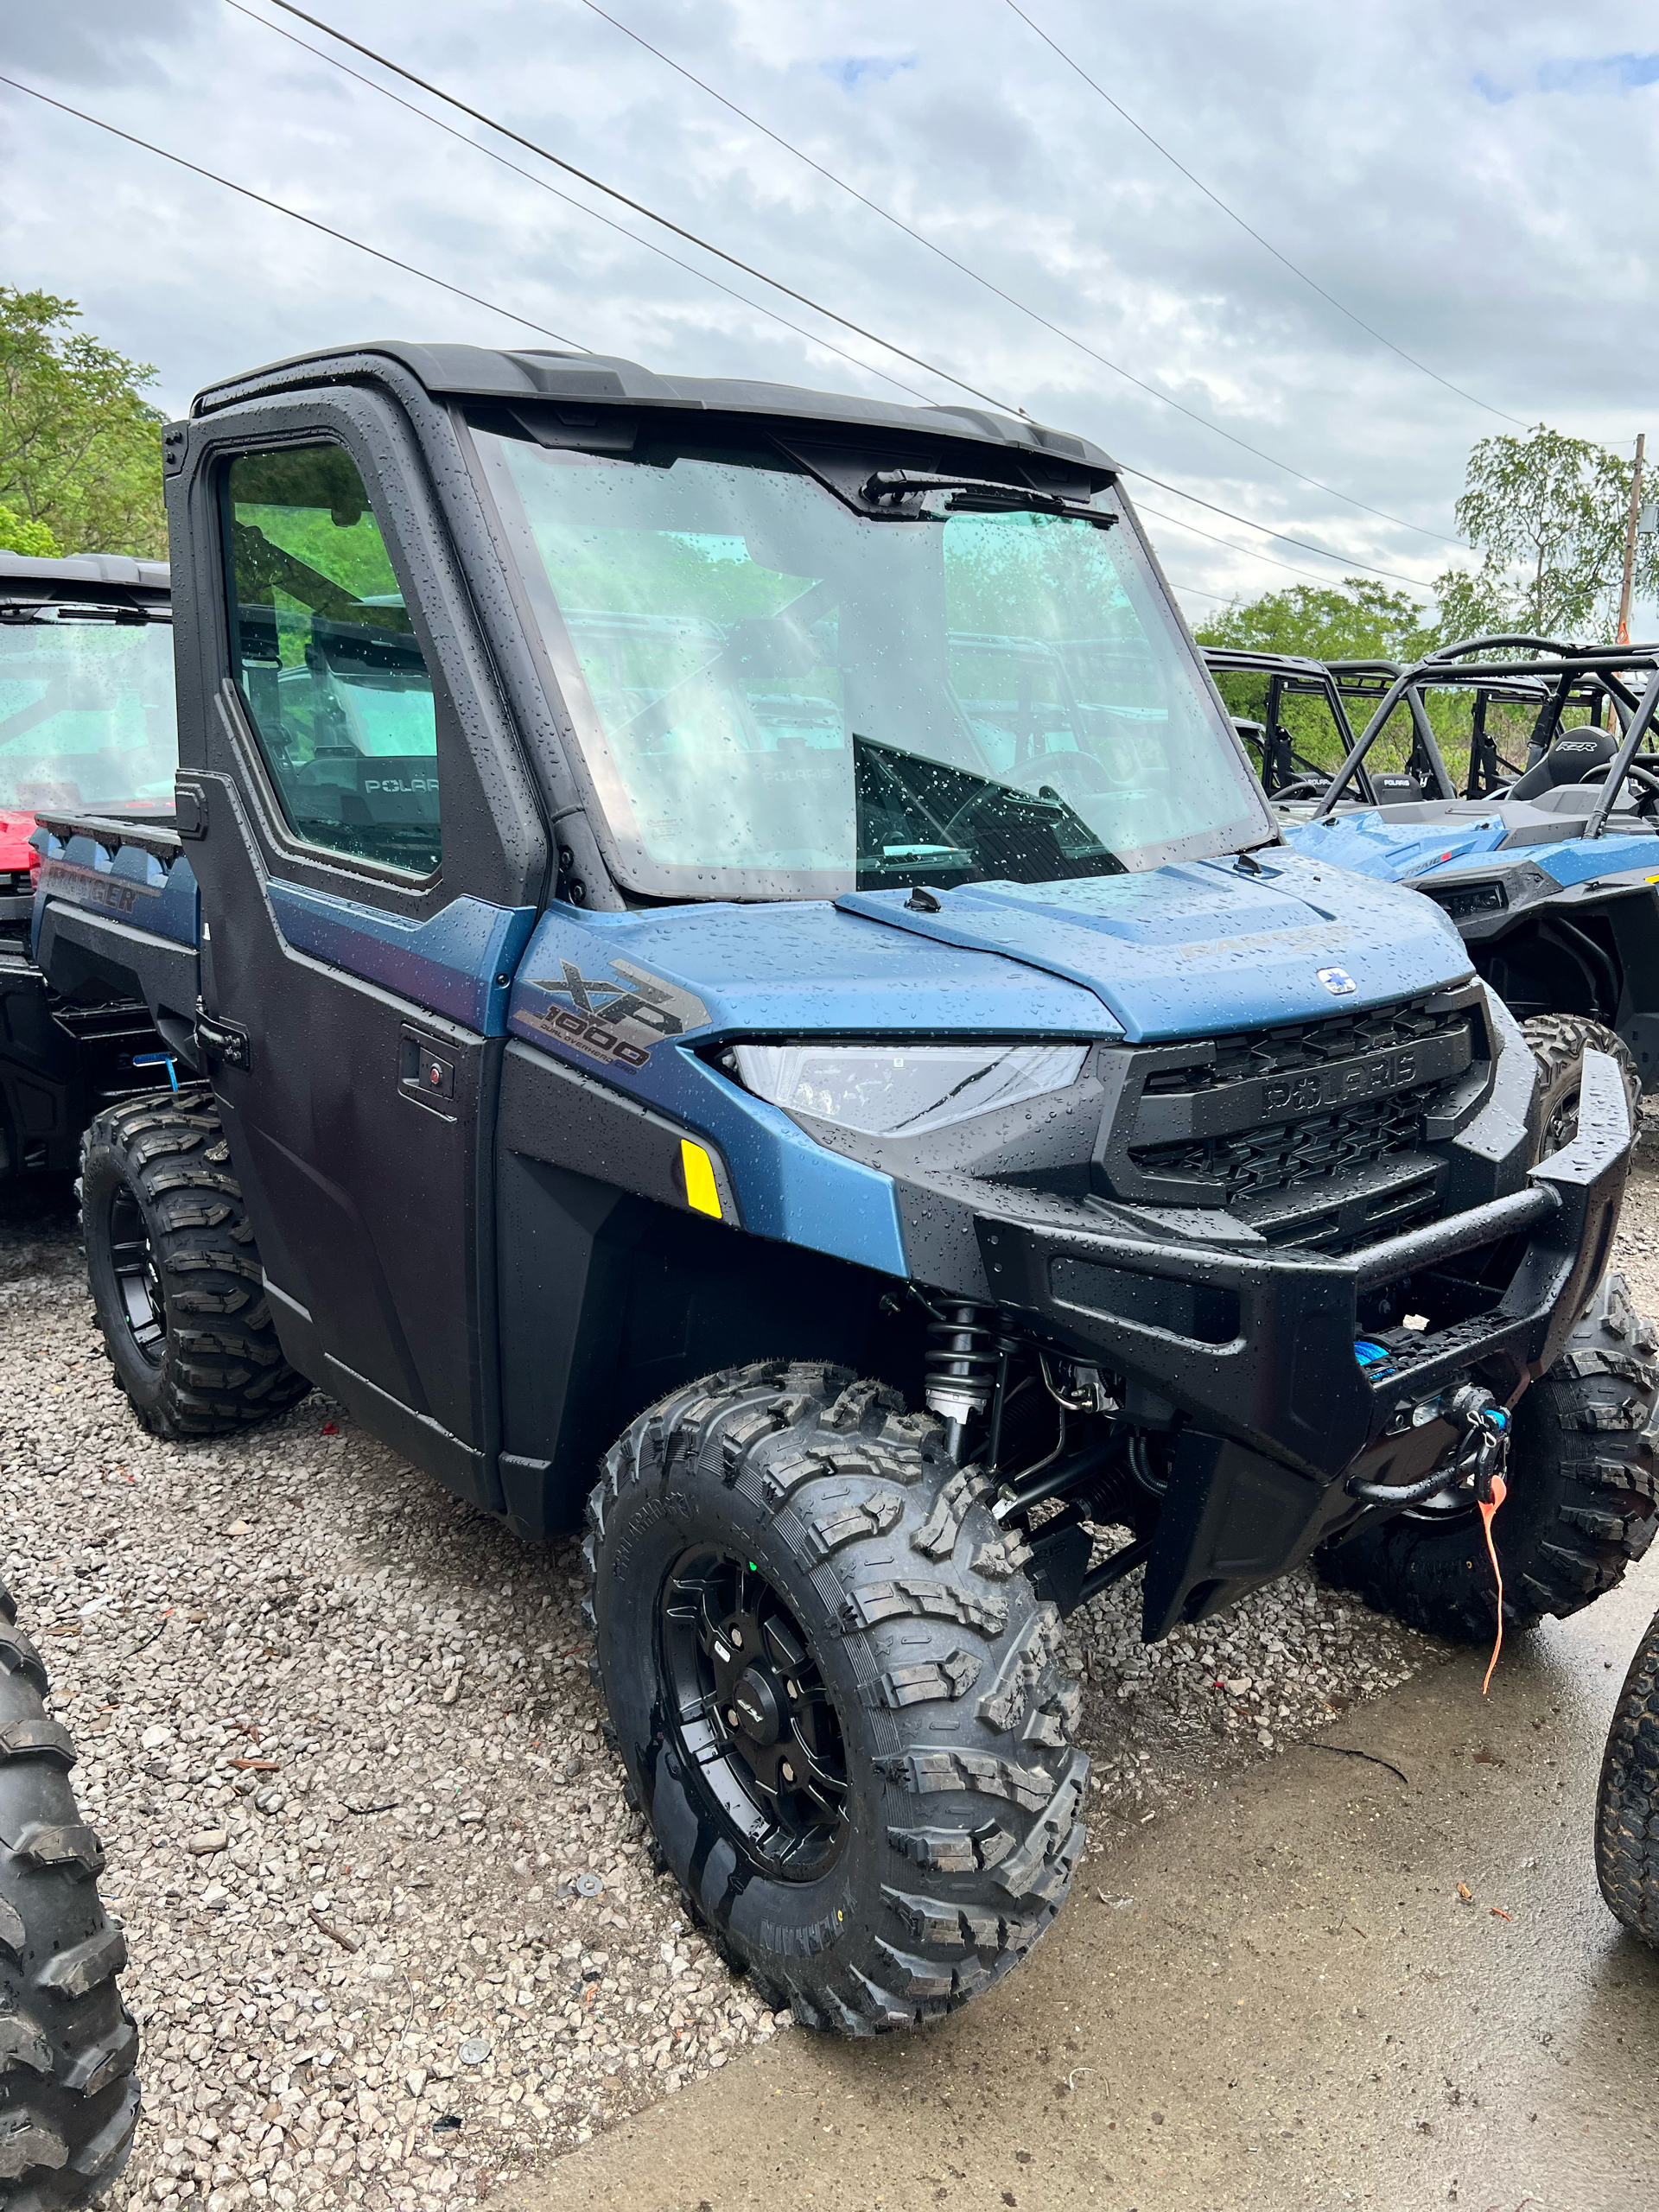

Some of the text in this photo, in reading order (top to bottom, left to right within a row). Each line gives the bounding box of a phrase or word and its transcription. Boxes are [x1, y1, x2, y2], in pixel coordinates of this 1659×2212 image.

[1555, 741, 1598, 752] RZR
[761, 768, 832, 784] POLARIS
[524, 957, 687, 1035] XP
[540, 1023, 563, 1039] DUAL
[563, 1034, 614, 1064] OVERHEAD
[543, 1004, 652, 1068] 1000
[1262, 1050, 1416, 1119] POLARIS
